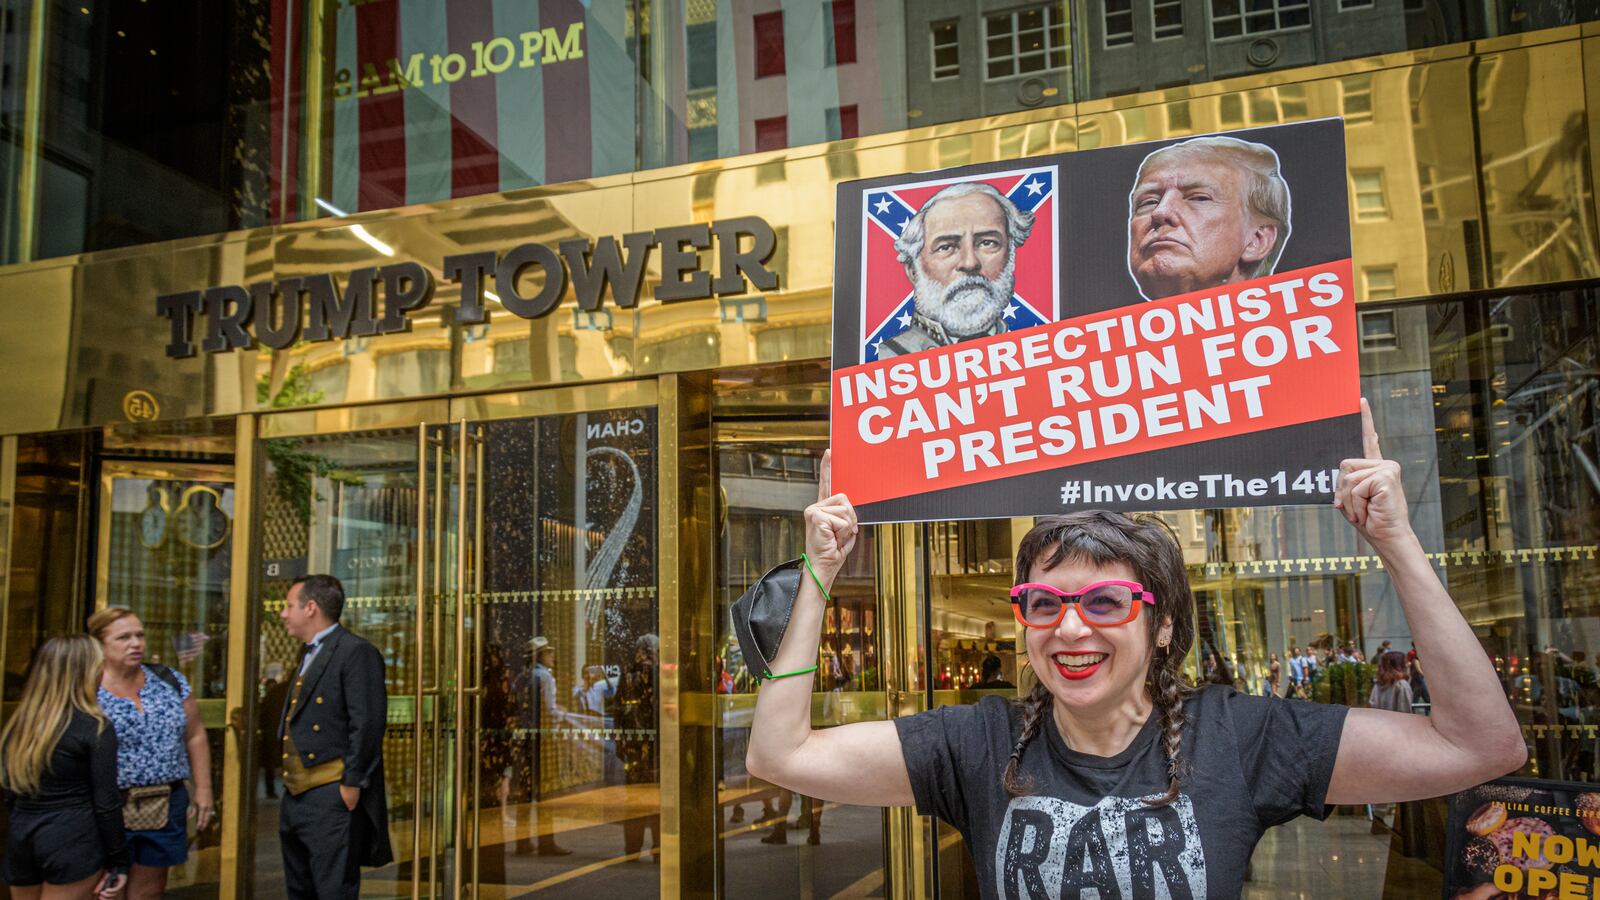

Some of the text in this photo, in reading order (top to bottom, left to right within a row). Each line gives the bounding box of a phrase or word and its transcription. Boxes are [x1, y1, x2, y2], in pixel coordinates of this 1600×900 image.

[355, 53, 425, 98] AM
[430, 53, 467, 84] to
[471, 37, 516, 77] 10
[519, 22, 584, 68] PM
[156, 215, 781, 359] TRUMP TOWER
[839, 272, 1344, 407] INSURRECTIONISTS
[857, 315, 1342, 444] CAN'T RUN FOR
[922, 374, 1272, 479] PRESIDENT
[1534, 805, 1571, 817] COFFEE
[1493, 863, 1600, 900] OPE
